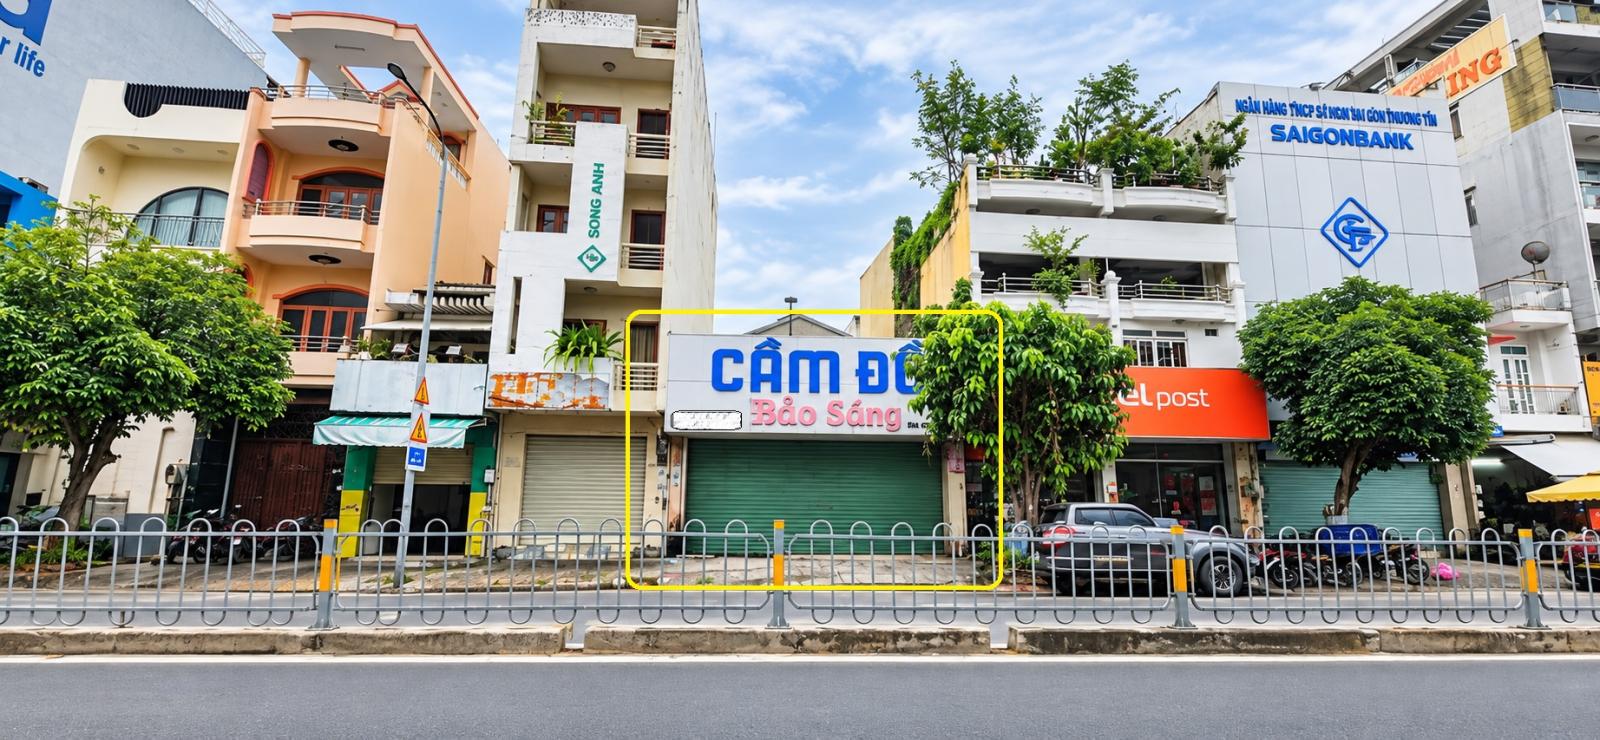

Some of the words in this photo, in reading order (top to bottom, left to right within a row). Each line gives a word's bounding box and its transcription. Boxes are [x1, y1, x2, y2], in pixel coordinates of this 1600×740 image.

[14, 42, 45, 77] life
[1270, 124, 1414, 150] SAIGONBANK
[591, 163, 605, 195] ANH
[588, 198, 602, 238] SONG
[750, 395, 817, 426] Bảo
[826, 399, 902, 433] Sáng
[1156, 388, 1210, 411] post
